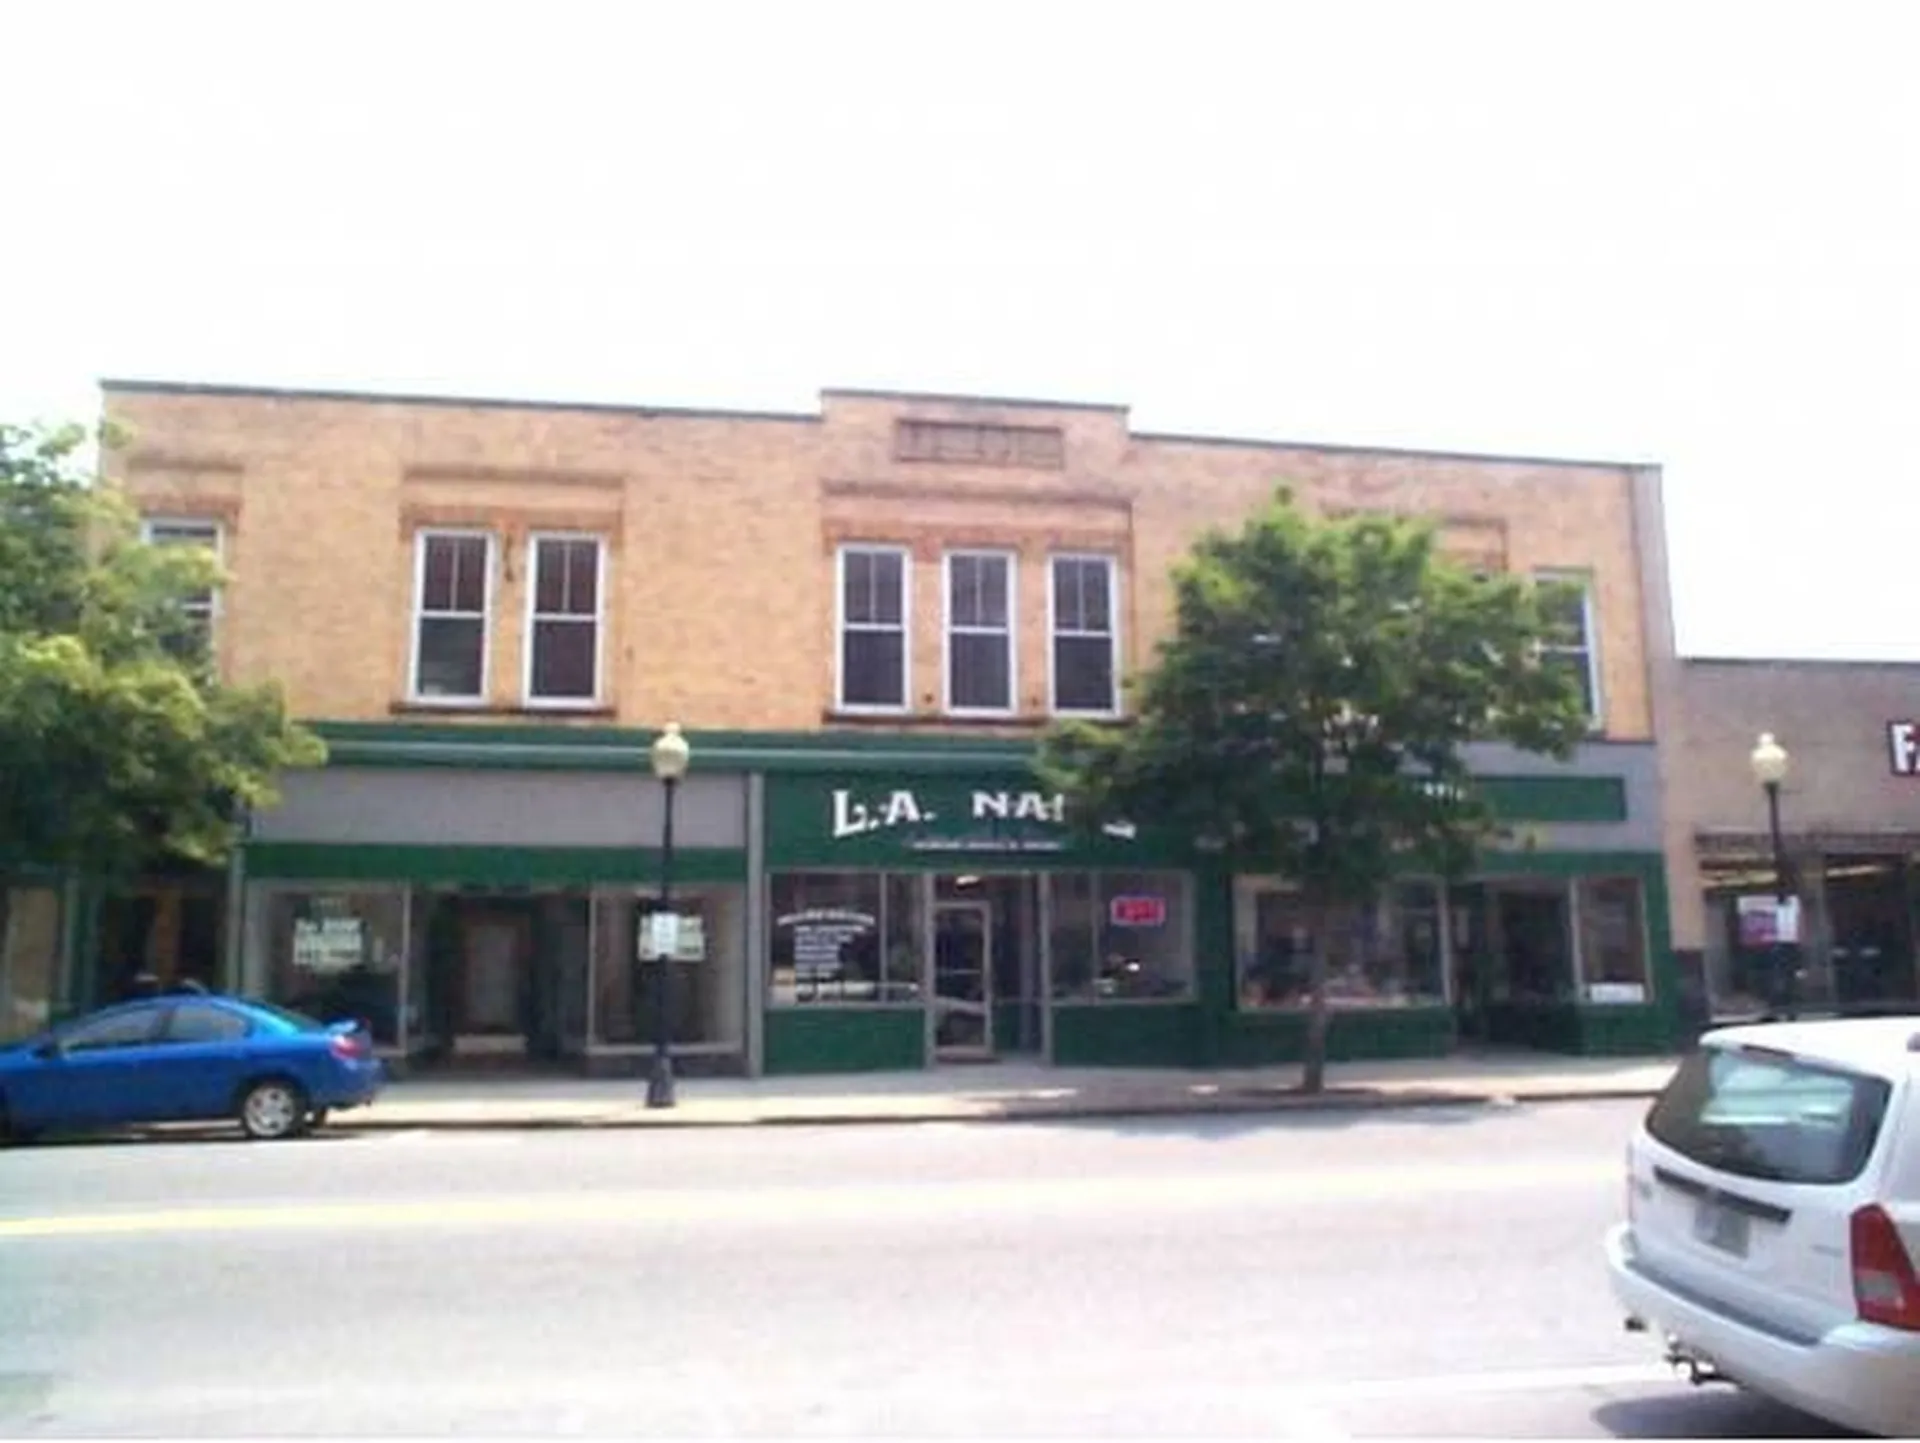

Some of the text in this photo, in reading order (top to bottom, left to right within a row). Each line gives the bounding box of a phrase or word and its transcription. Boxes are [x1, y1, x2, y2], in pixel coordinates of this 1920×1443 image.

[1891, 723, 1920, 772] F
[832, 789, 1137, 839] L.A. NAI
